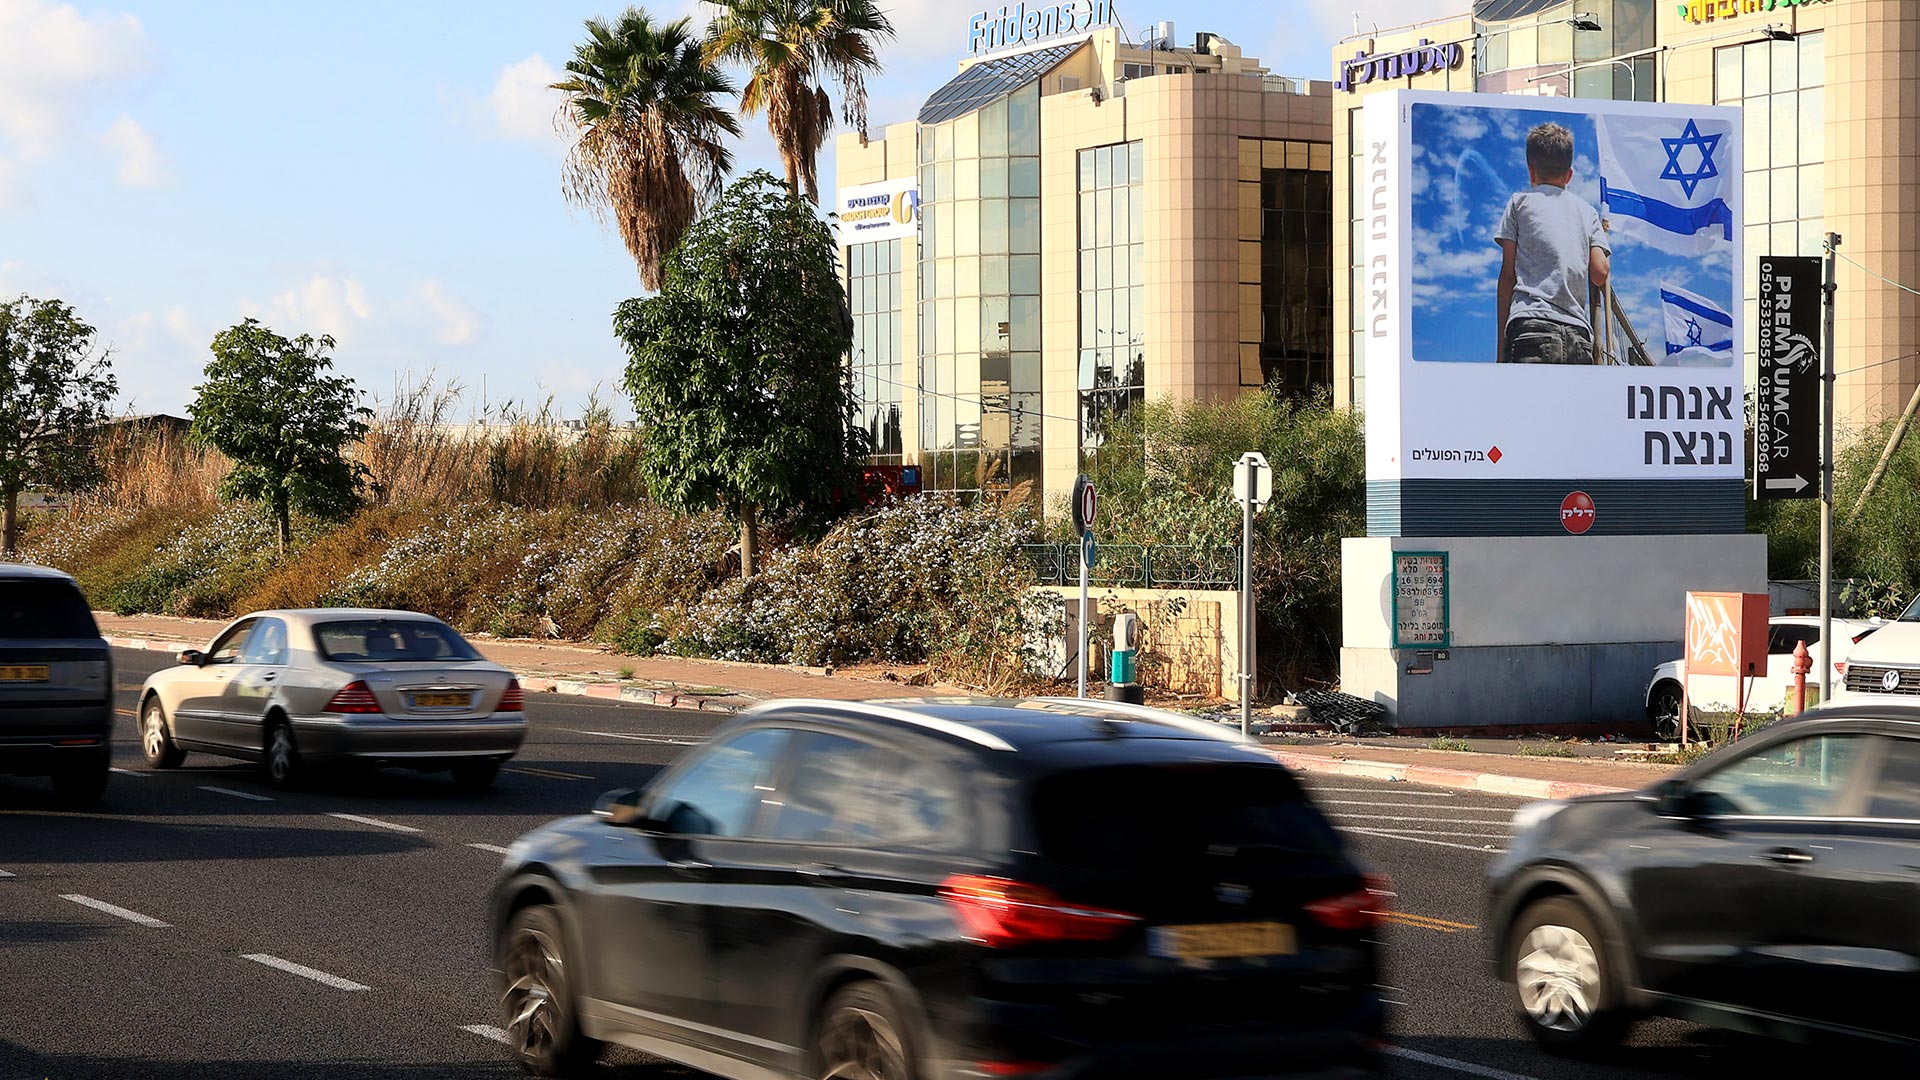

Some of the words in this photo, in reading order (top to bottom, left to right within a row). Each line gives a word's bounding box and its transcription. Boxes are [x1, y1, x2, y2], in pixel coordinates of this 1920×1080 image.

[967, 0, 1112, 53] Fridenson
[1372, 140, 1387, 241] אנחנו
[1372, 254, 1387, 338] ננצח
[1760, 263, 1772, 367] 050-5330855
[1627, 385, 1733, 420] אנחנו
[1758, 376, 1771, 473] 03-5466968
[1412, 448, 1461, 461] הפועלים
[1464, 450, 1484, 463] בנק
[1644, 431, 1733, 465] ננצח
[1562, 506, 1594, 520] דלק
[1427, 576, 1443, 584] 694
[1428, 633, 1444, 641] שבת
